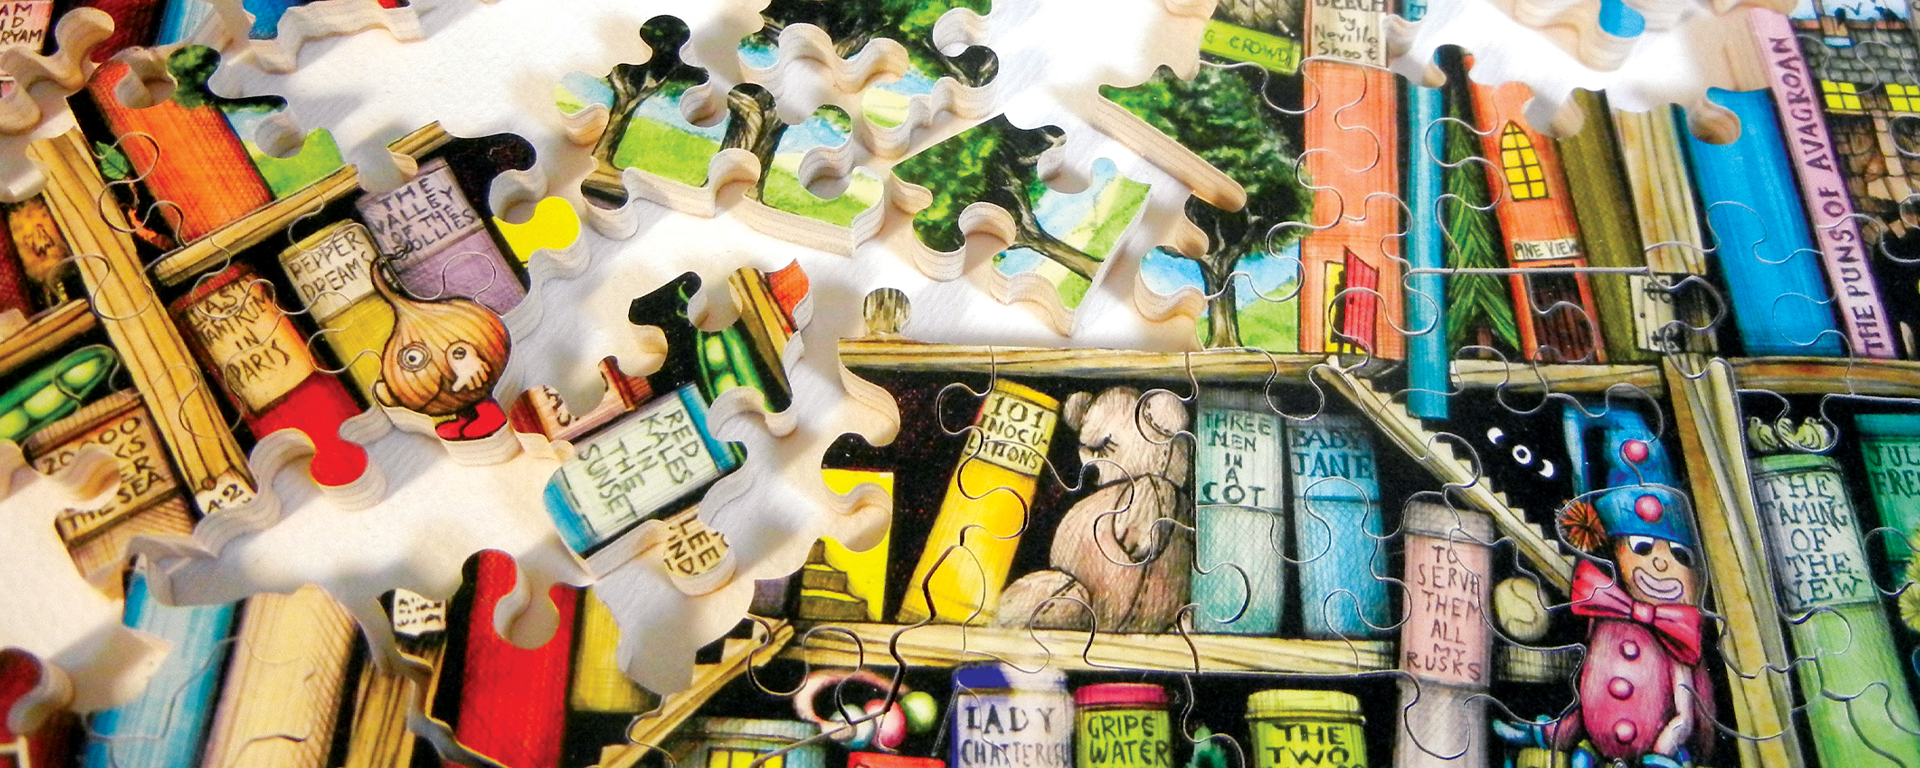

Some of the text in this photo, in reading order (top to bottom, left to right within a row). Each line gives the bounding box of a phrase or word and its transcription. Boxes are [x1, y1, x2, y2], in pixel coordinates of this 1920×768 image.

[1338, 11, 1357, 31] by
[1317, 41, 1378, 60] Shoot
[376, 178, 434, 212] THE
[1768, 37, 1885, 357] THE PUNS OF AVAGROAN
[372, 185, 453, 235] VALLEY
[390, 225, 413, 244] OF
[287, 231, 364, 282] PEPPER
[1513, 239, 1581, 260] PINE VIEW
[198, 295, 267, 348] TANTRUM
[235, 326, 261, 350] IN
[227, 339, 290, 389] PARIS
[990, 396, 1045, 429] 101
[1202, 412, 1272, 436] THREE
[663, 409, 700, 458] RED
[1207, 430, 1257, 452] MEN
[1291, 428, 1365, 450] BABY
[636, 445, 660, 473] IN
[640, 412, 695, 485] KALES
[1224, 452, 1243, 469] IN
[1866, 444, 1920, 468] JUL
[608, 438, 646, 493] THE
[1225, 467, 1240, 485] A
[1291, 450, 1374, 479] JANE
[116, 471, 167, 504] SEA
[578, 443, 638, 523] SUNSET
[1202, 480, 1266, 507] COT
[1763, 474, 1836, 500] THE
[1870, 468, 1920, 499] FRE
[1760, 499, 1848, 534] TAMING
[1790, 527, 1832, 553] OF
[1431, 545, 1459, 564] TO
[1417, 563, 1482, 595] SERVE
[1421, 588, 1483, 624] THEM
[1430, 618, 1467, 646] ALL
[1432, 642, 1467, 661] MY
[1405, 650, 1482, 683] RUSKS
[964, 703, 1056, 736] LADY
[1087, 713, 1156, 739] GRIPE
[1271, 723, 1345, 746] THE
[1089, 738, 1169, 768] WATER
[1265, 746, 1351, 766] TWO
